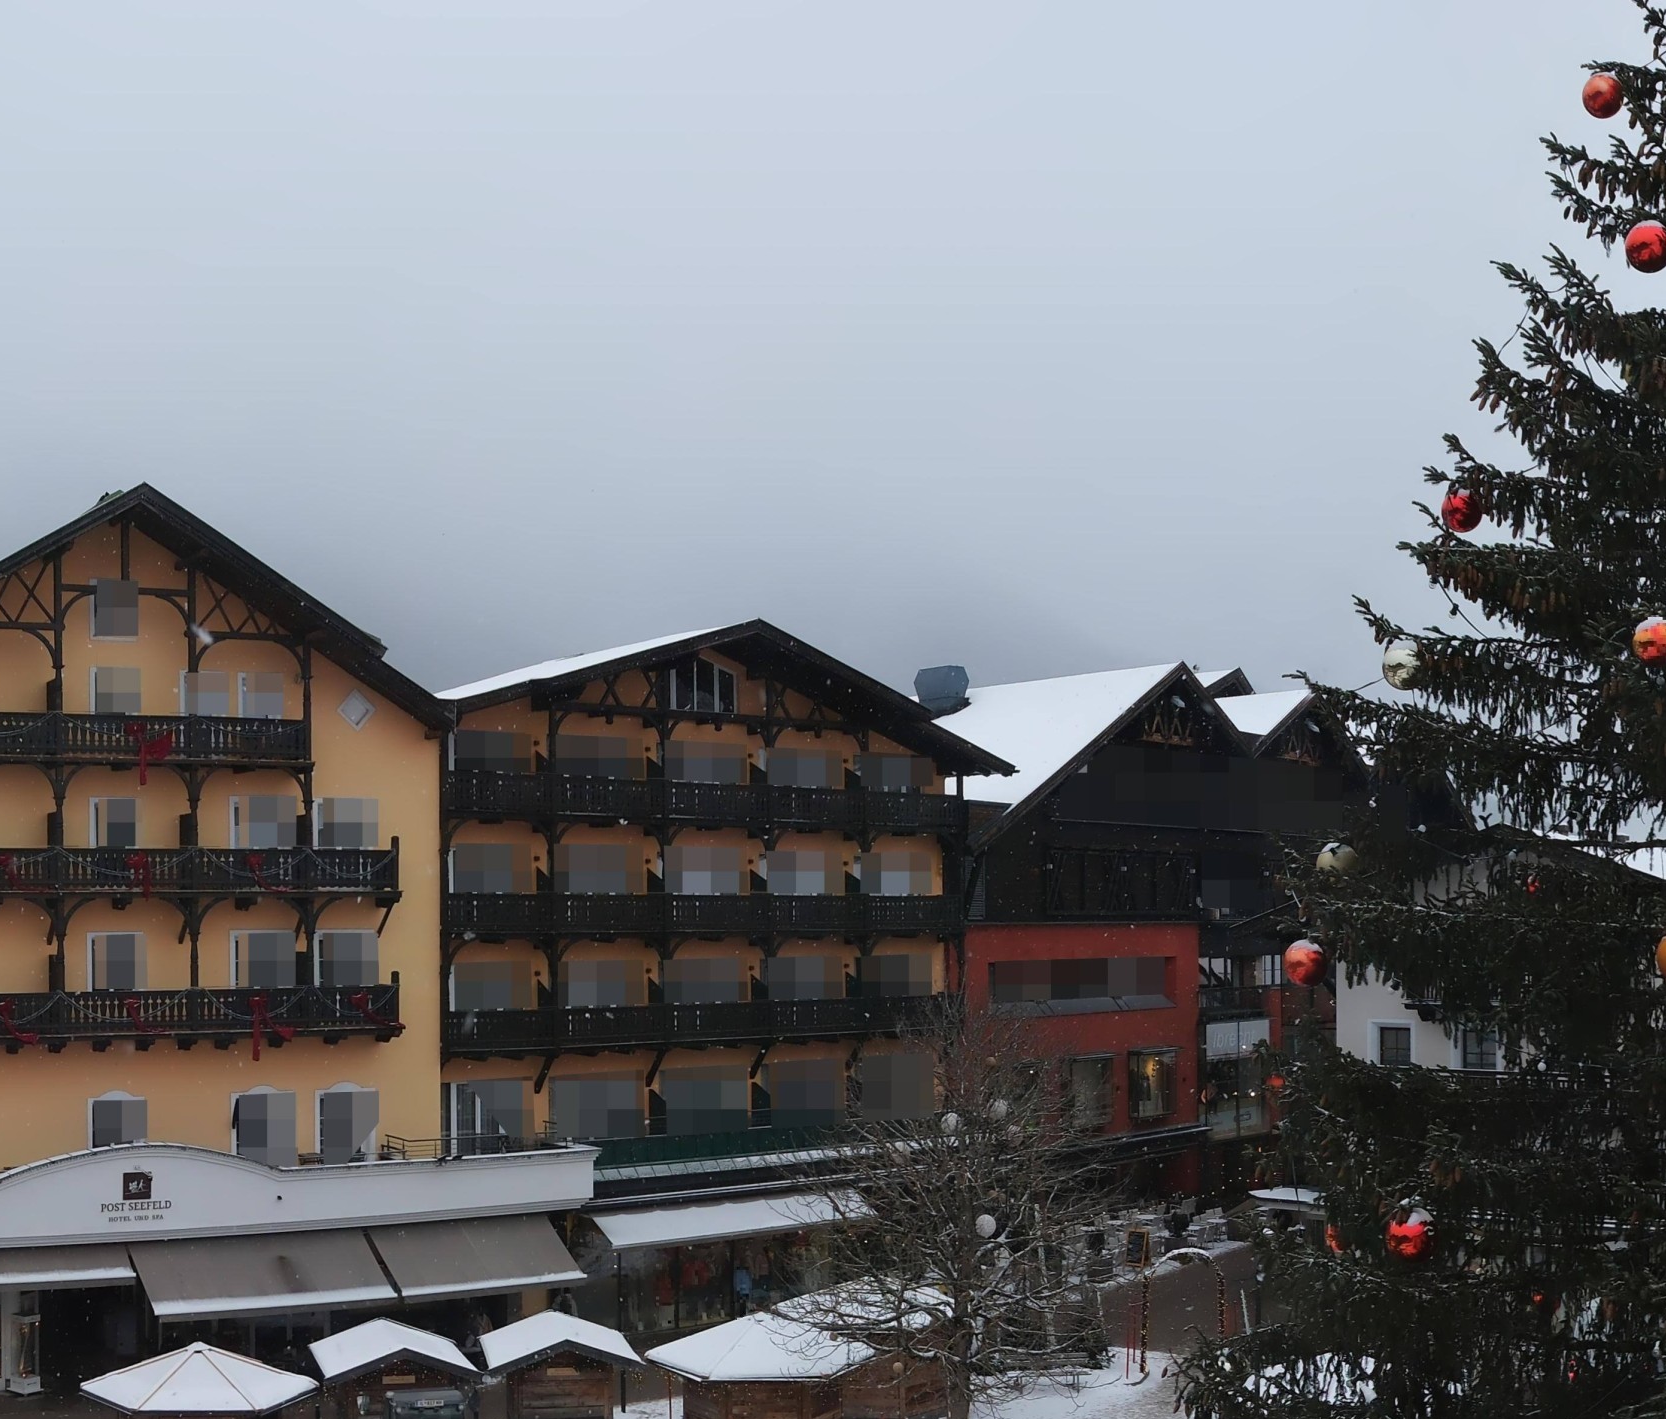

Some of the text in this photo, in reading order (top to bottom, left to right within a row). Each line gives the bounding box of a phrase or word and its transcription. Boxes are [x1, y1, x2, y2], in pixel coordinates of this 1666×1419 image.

[100, 1200, 172, 1213] POST SEEFELD
[108, 1215, 132, 1223] HOTEL
